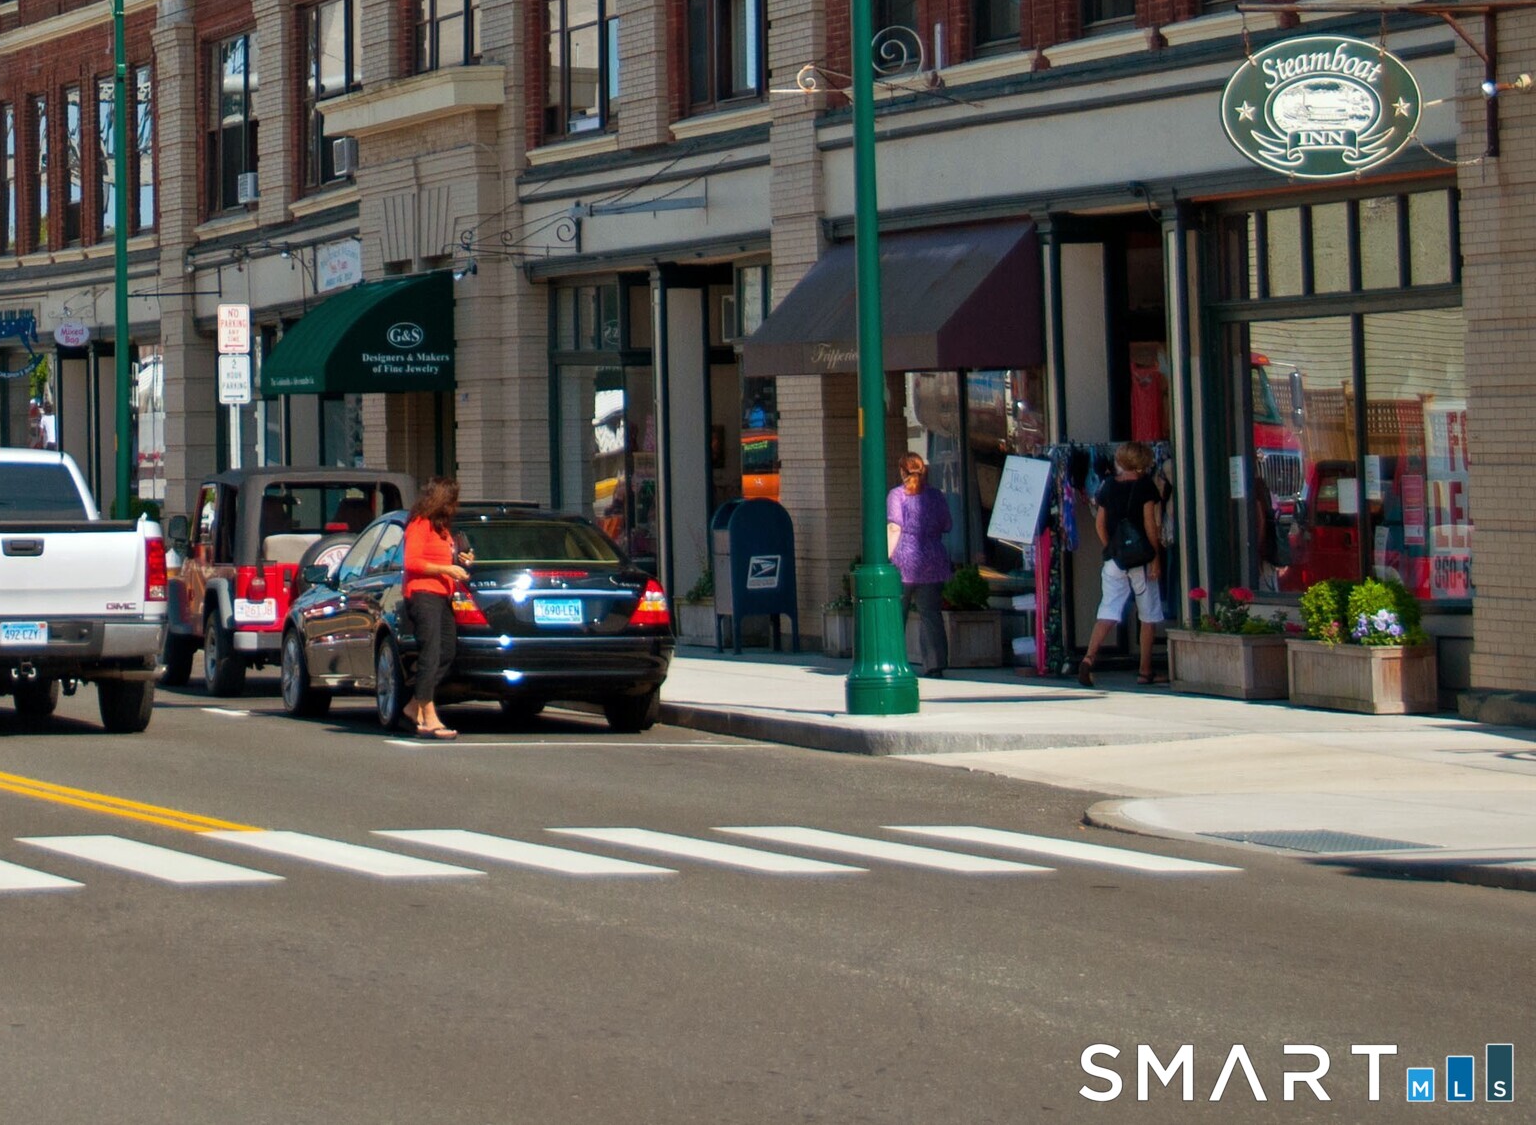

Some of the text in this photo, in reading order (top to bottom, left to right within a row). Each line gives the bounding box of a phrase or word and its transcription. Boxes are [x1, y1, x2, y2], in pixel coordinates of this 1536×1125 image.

[1262, 42, 1383, 89] Steamboat
[1298, 129, 1348, 146] INN
[228, 308, 239, 318] NO
[221, 319, 247, 328] PARKING
[61, 328, 84, 336] Mixed
[389, 328, 421, 342] G&S
[65, 335, 80, 345] Bag
[362, 352, 450, 363] Designers & Makers
[231, 358, 237, 369] 2
[372, 364, 440, 375] of Fine Jewelry
[222, 381, 248, 390] PARKING
[106, 602, 137, 610] GMC
